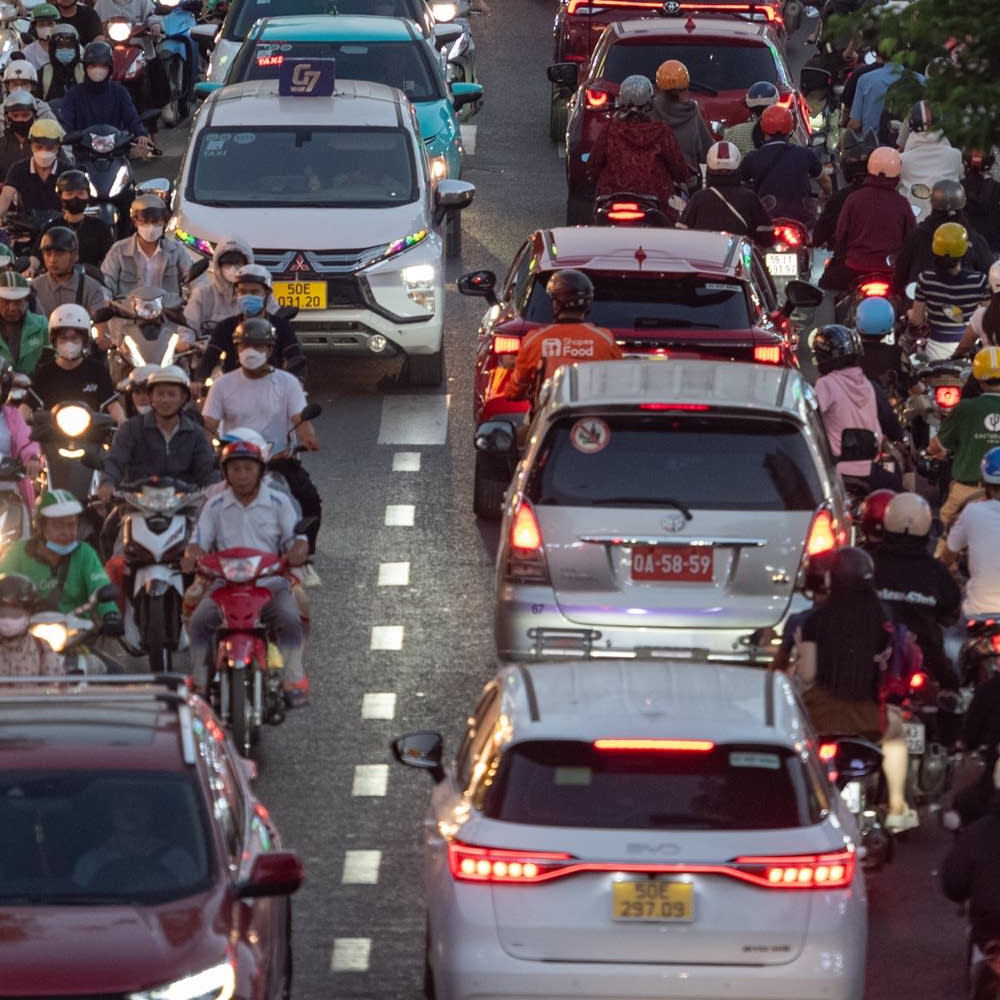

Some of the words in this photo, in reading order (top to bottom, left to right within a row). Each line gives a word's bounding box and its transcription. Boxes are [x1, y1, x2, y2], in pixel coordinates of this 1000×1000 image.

[291, 63, 321, 92] G7
[287, 283, 311, 295] 50E
[278, 296, 321, 308] 031.20
[563, 345, 594, 357] Food
[531, 604, 545, 615] 67
[635, 882, 670, 900] 50E
[620, 902, 685, 918] 297.09
